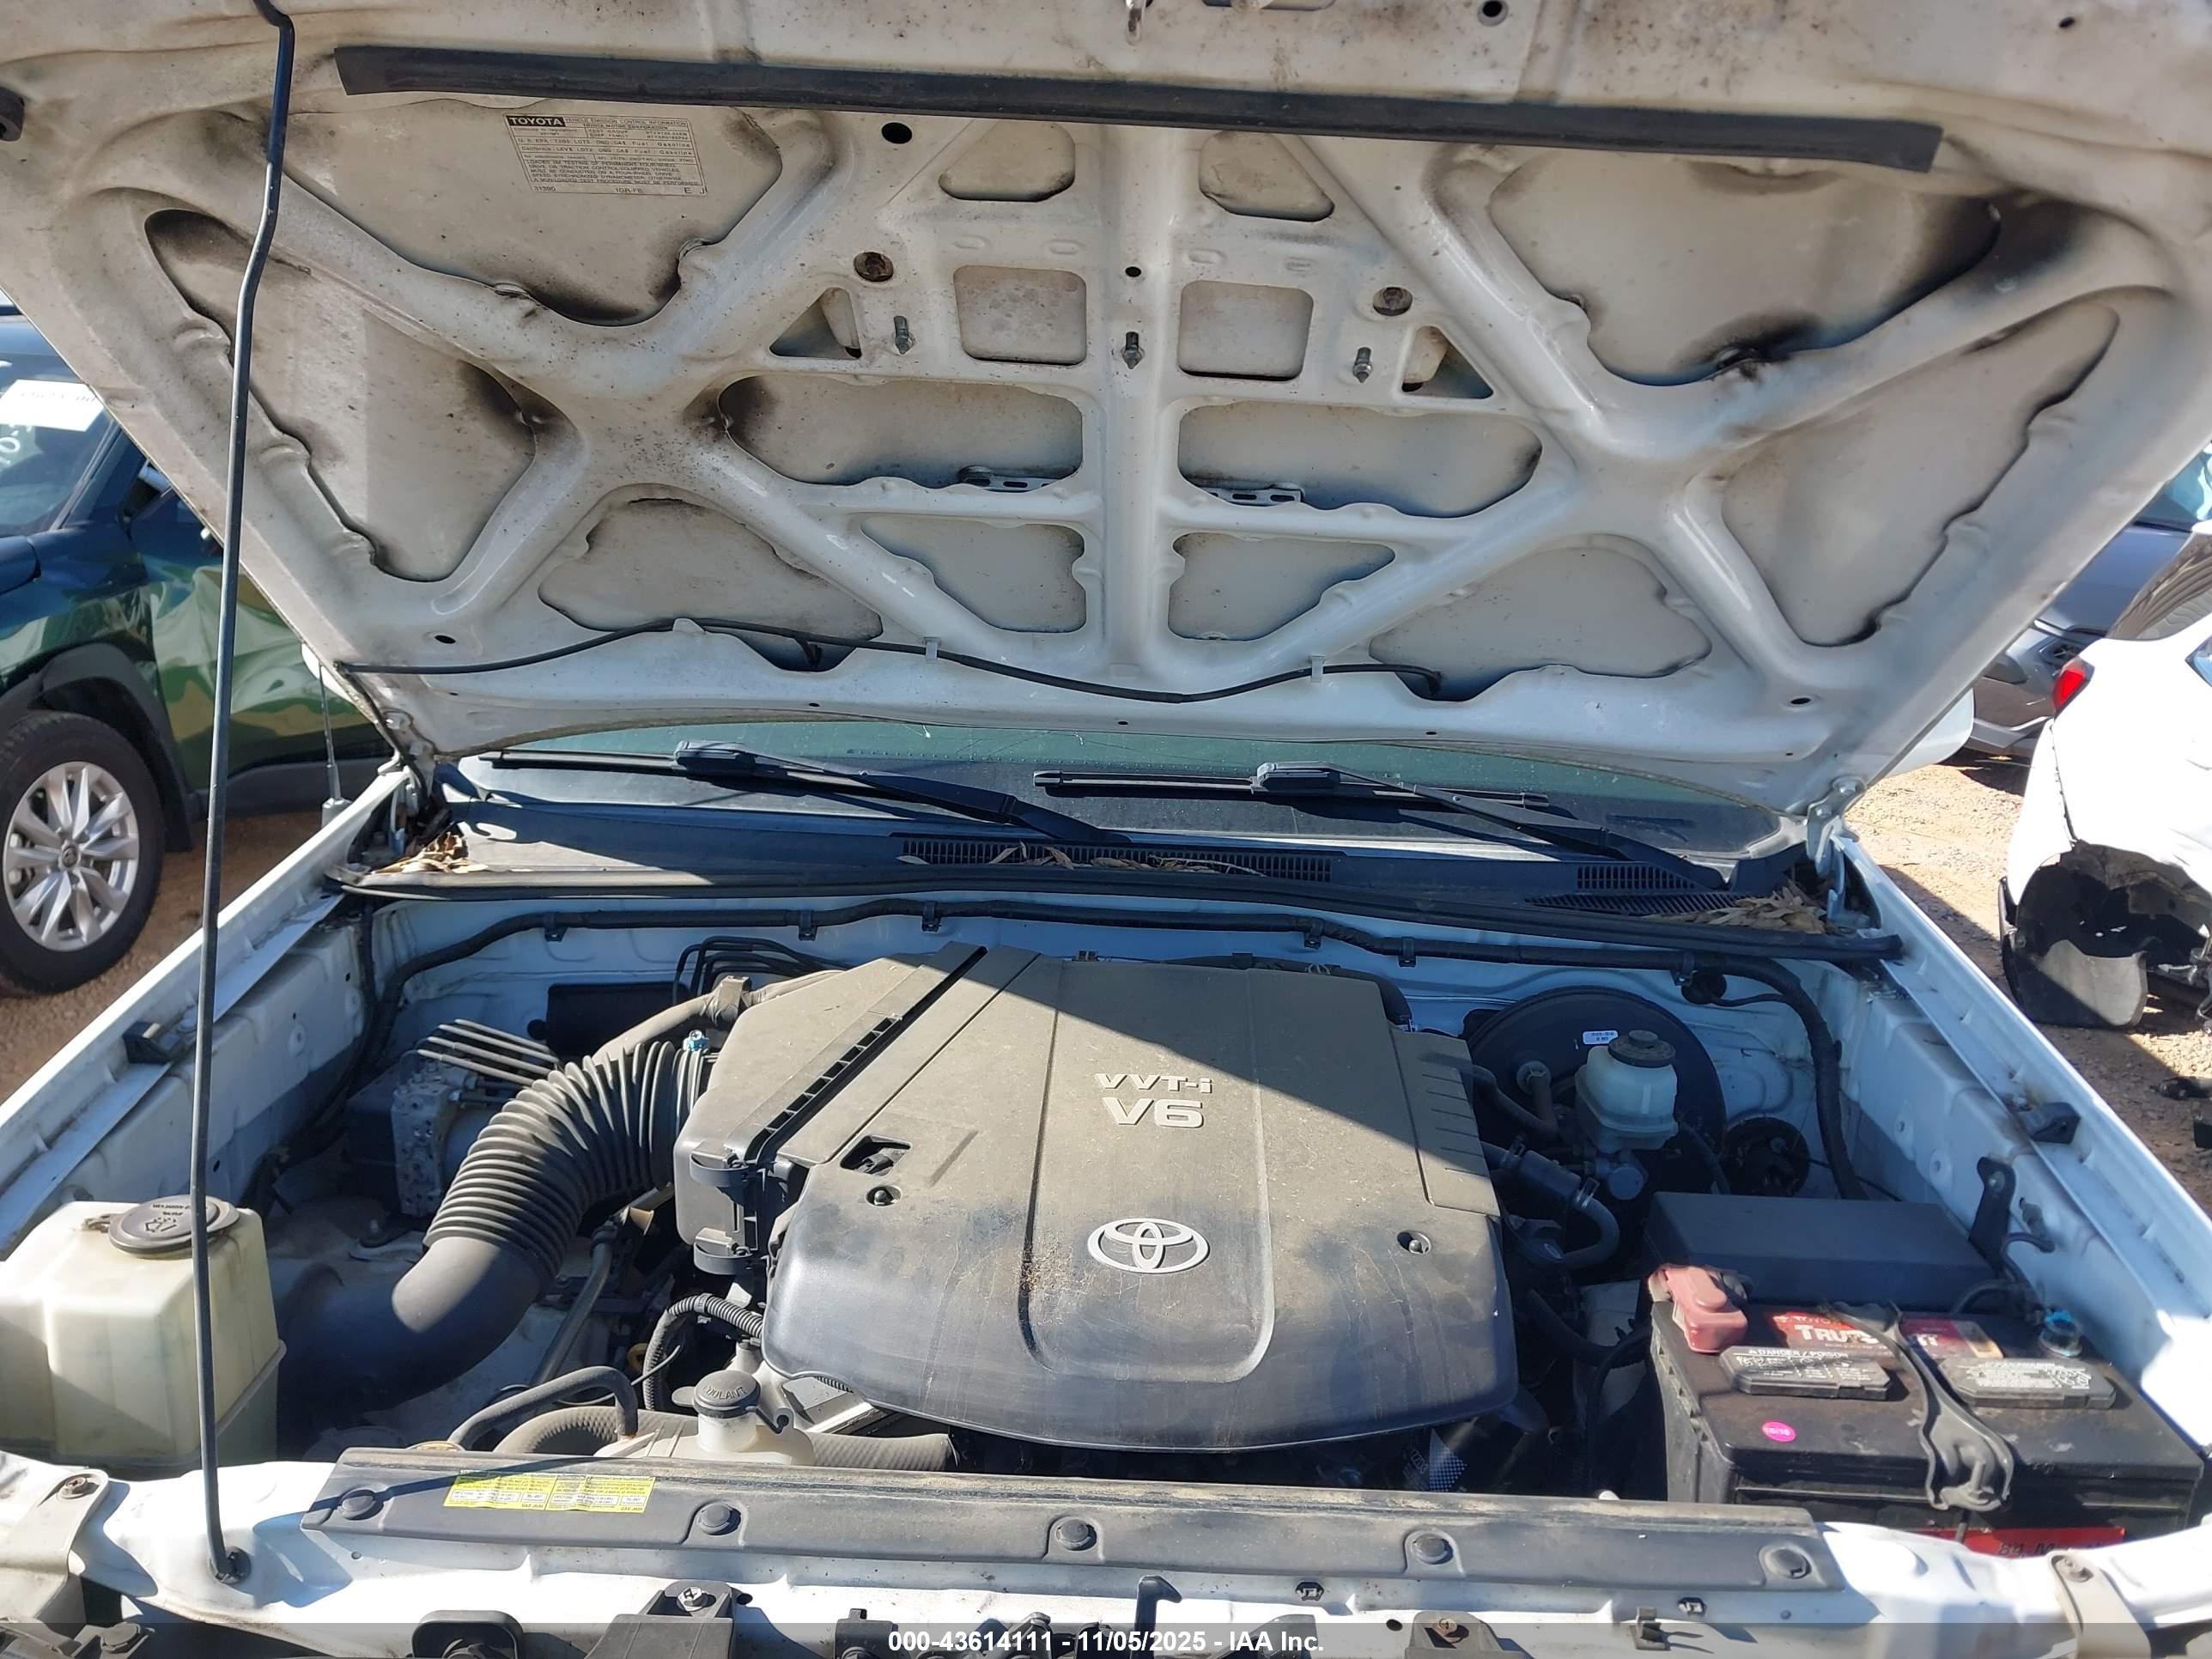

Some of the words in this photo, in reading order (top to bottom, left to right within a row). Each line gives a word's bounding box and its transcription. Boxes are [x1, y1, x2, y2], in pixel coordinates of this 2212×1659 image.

[509, 117, 563, 126] TOYOTA
[1095, 1073, 1212, 1093] VVT-i
[1103, 1097, 1204, 1128] V6
